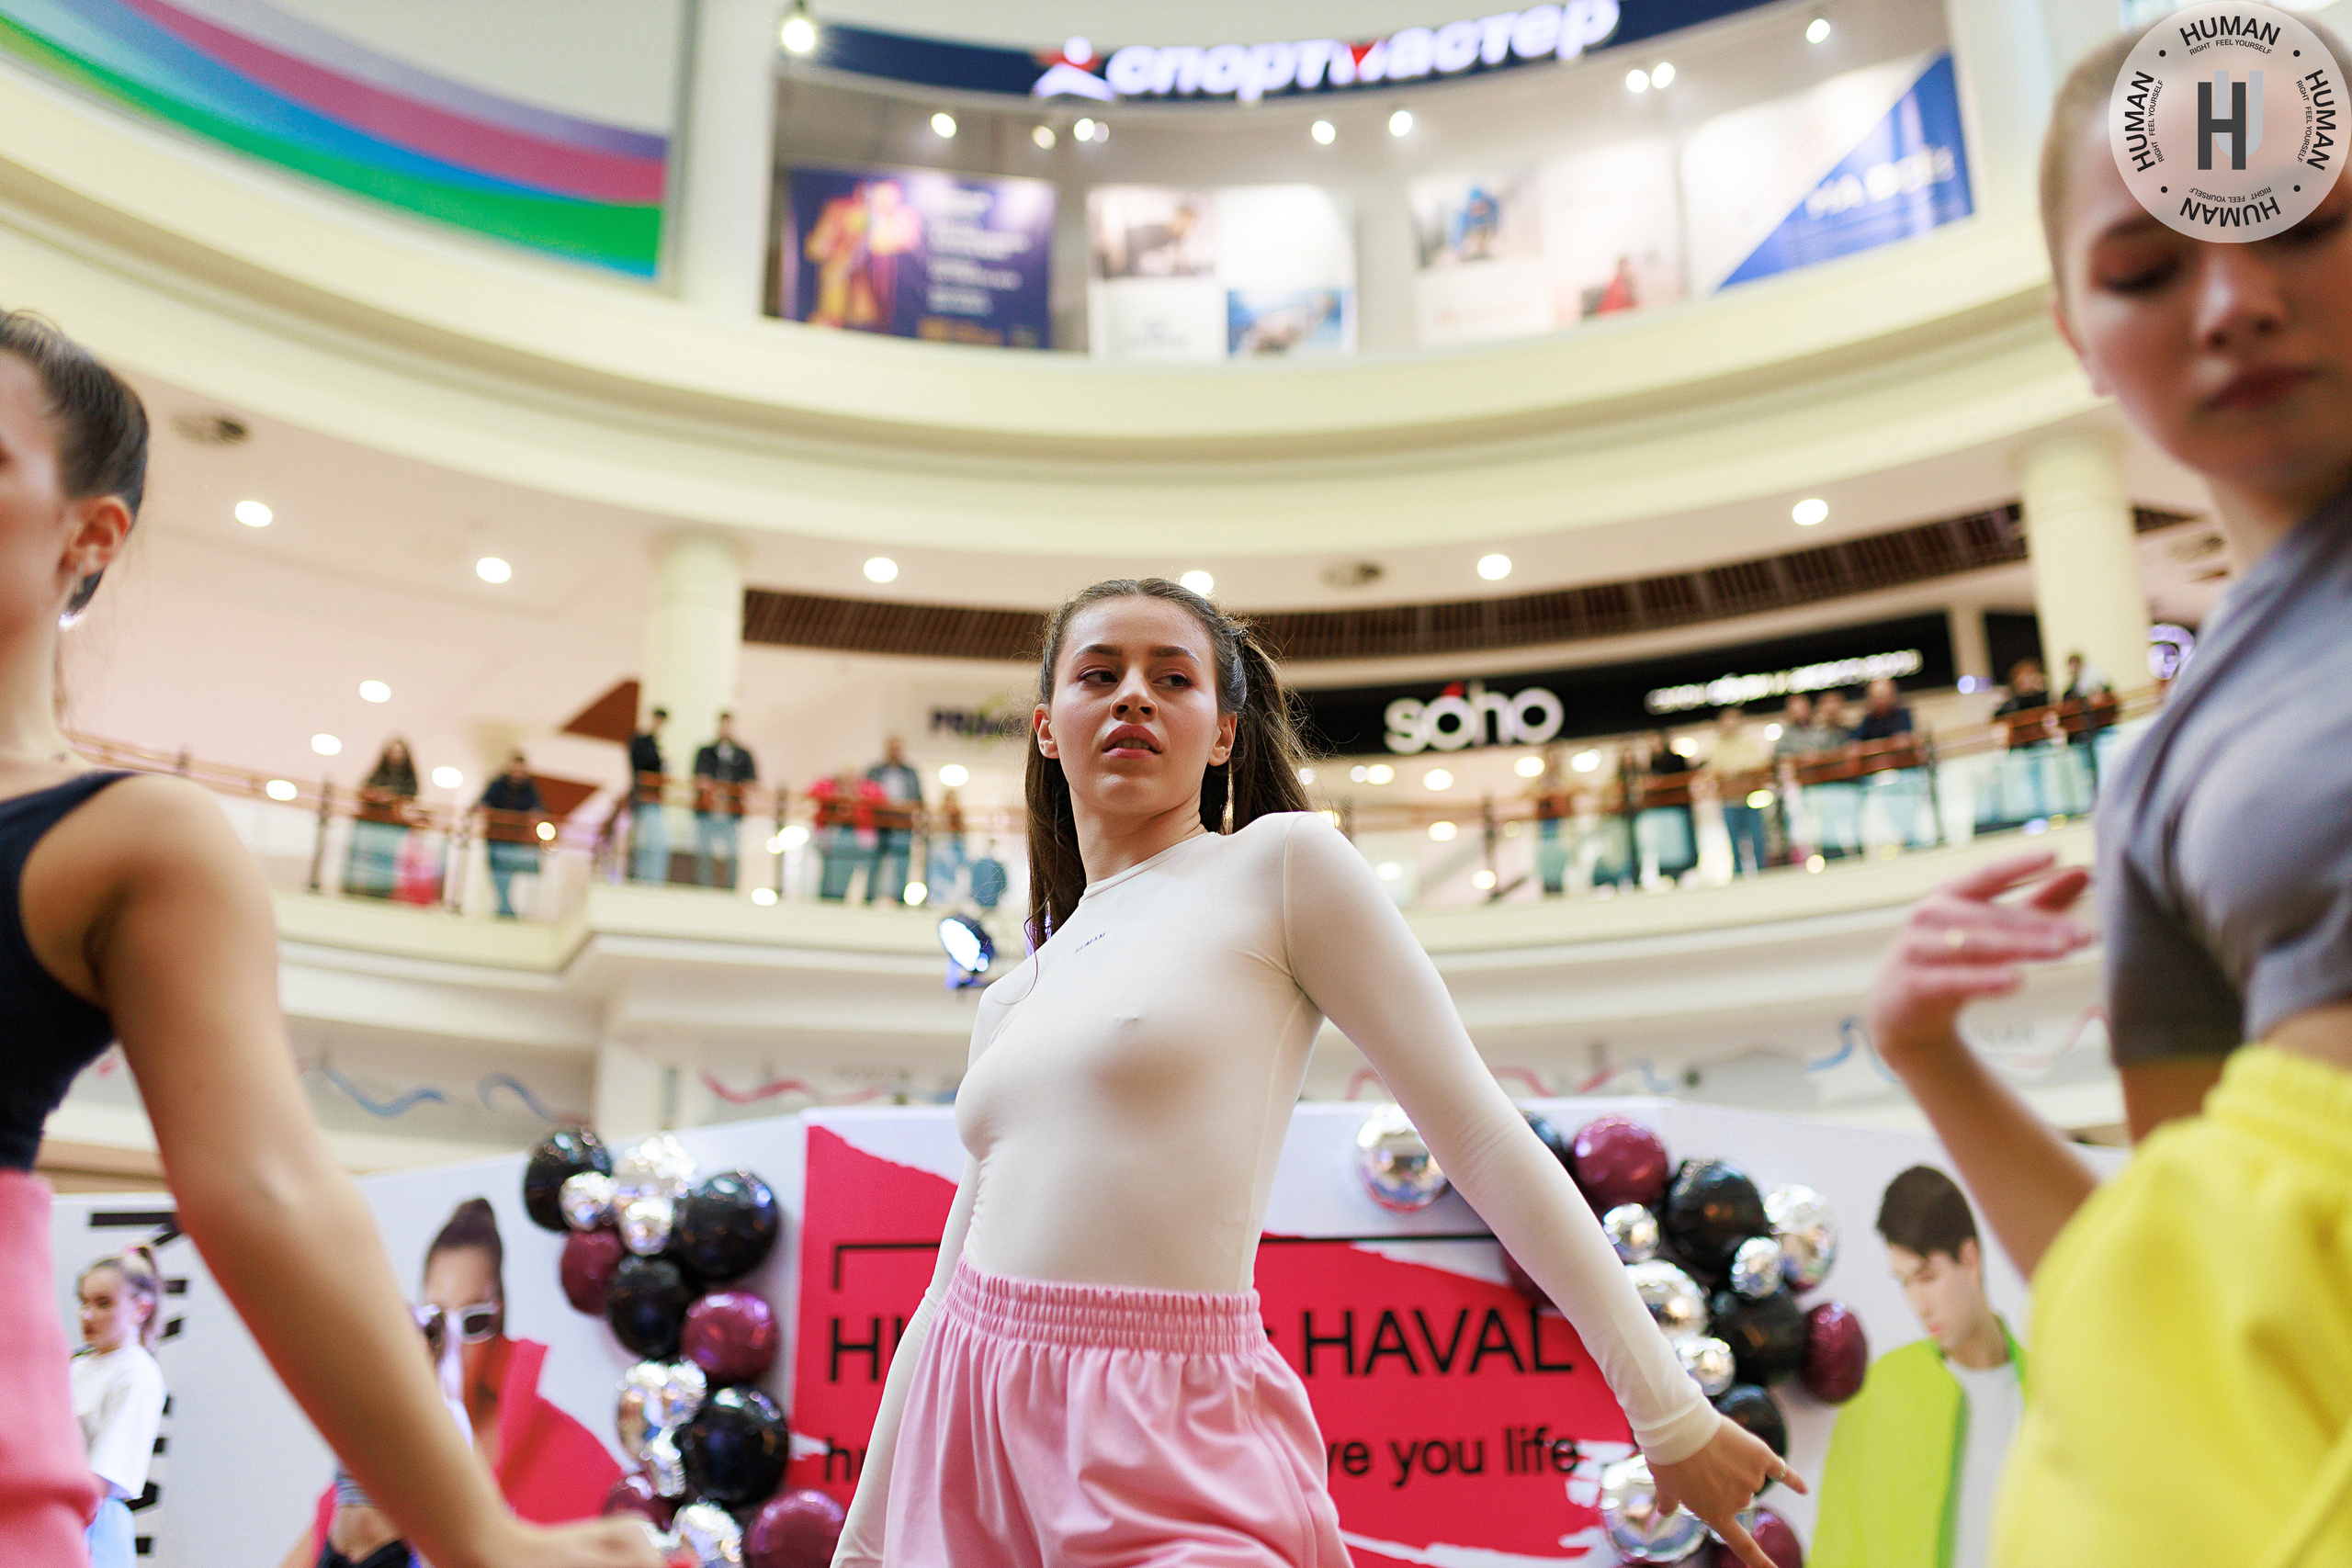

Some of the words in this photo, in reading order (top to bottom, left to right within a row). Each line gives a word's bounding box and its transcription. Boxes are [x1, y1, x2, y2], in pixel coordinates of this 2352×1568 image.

[1302, 1306, 1573, 1375] HAVAL
[1389, 1439, 1485, 1488] you
[1504, 1427, 1578, 1475] life
